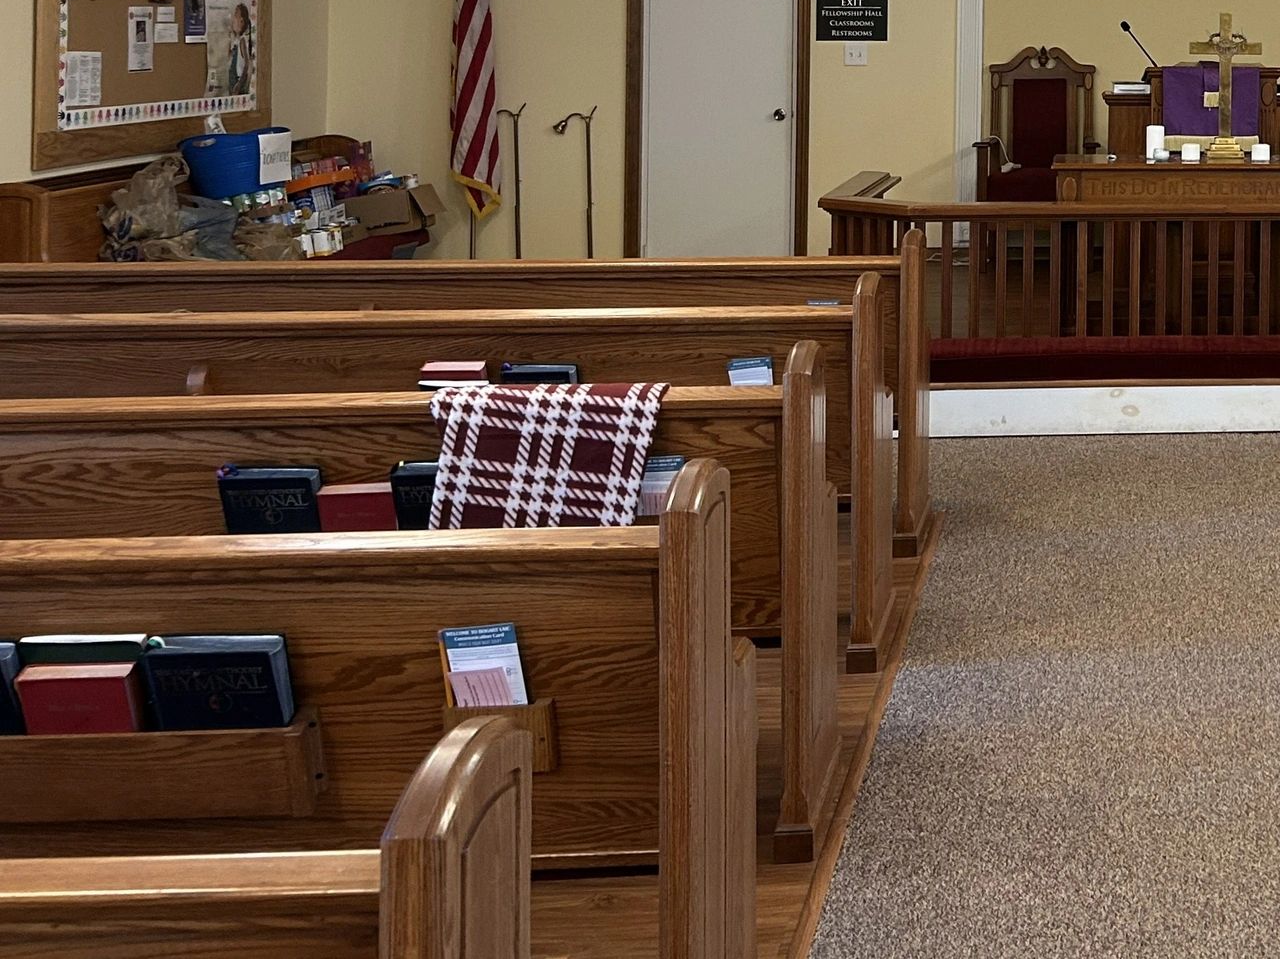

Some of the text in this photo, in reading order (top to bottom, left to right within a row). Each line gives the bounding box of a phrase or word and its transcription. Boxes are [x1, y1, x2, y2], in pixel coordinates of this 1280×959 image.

[821, 9, 863, 17] FELLOWSHIP
[829, 19, 874, 27] CLASSROOMS
[1086, 177, 1128, 196] THIS
[1131, 177, 1156, 196] DO
[1161, 177, 1179, 196] IN
[231, 493, 310, 508] HYMNAL
[160, 672, 267, 691] HYMNAL
